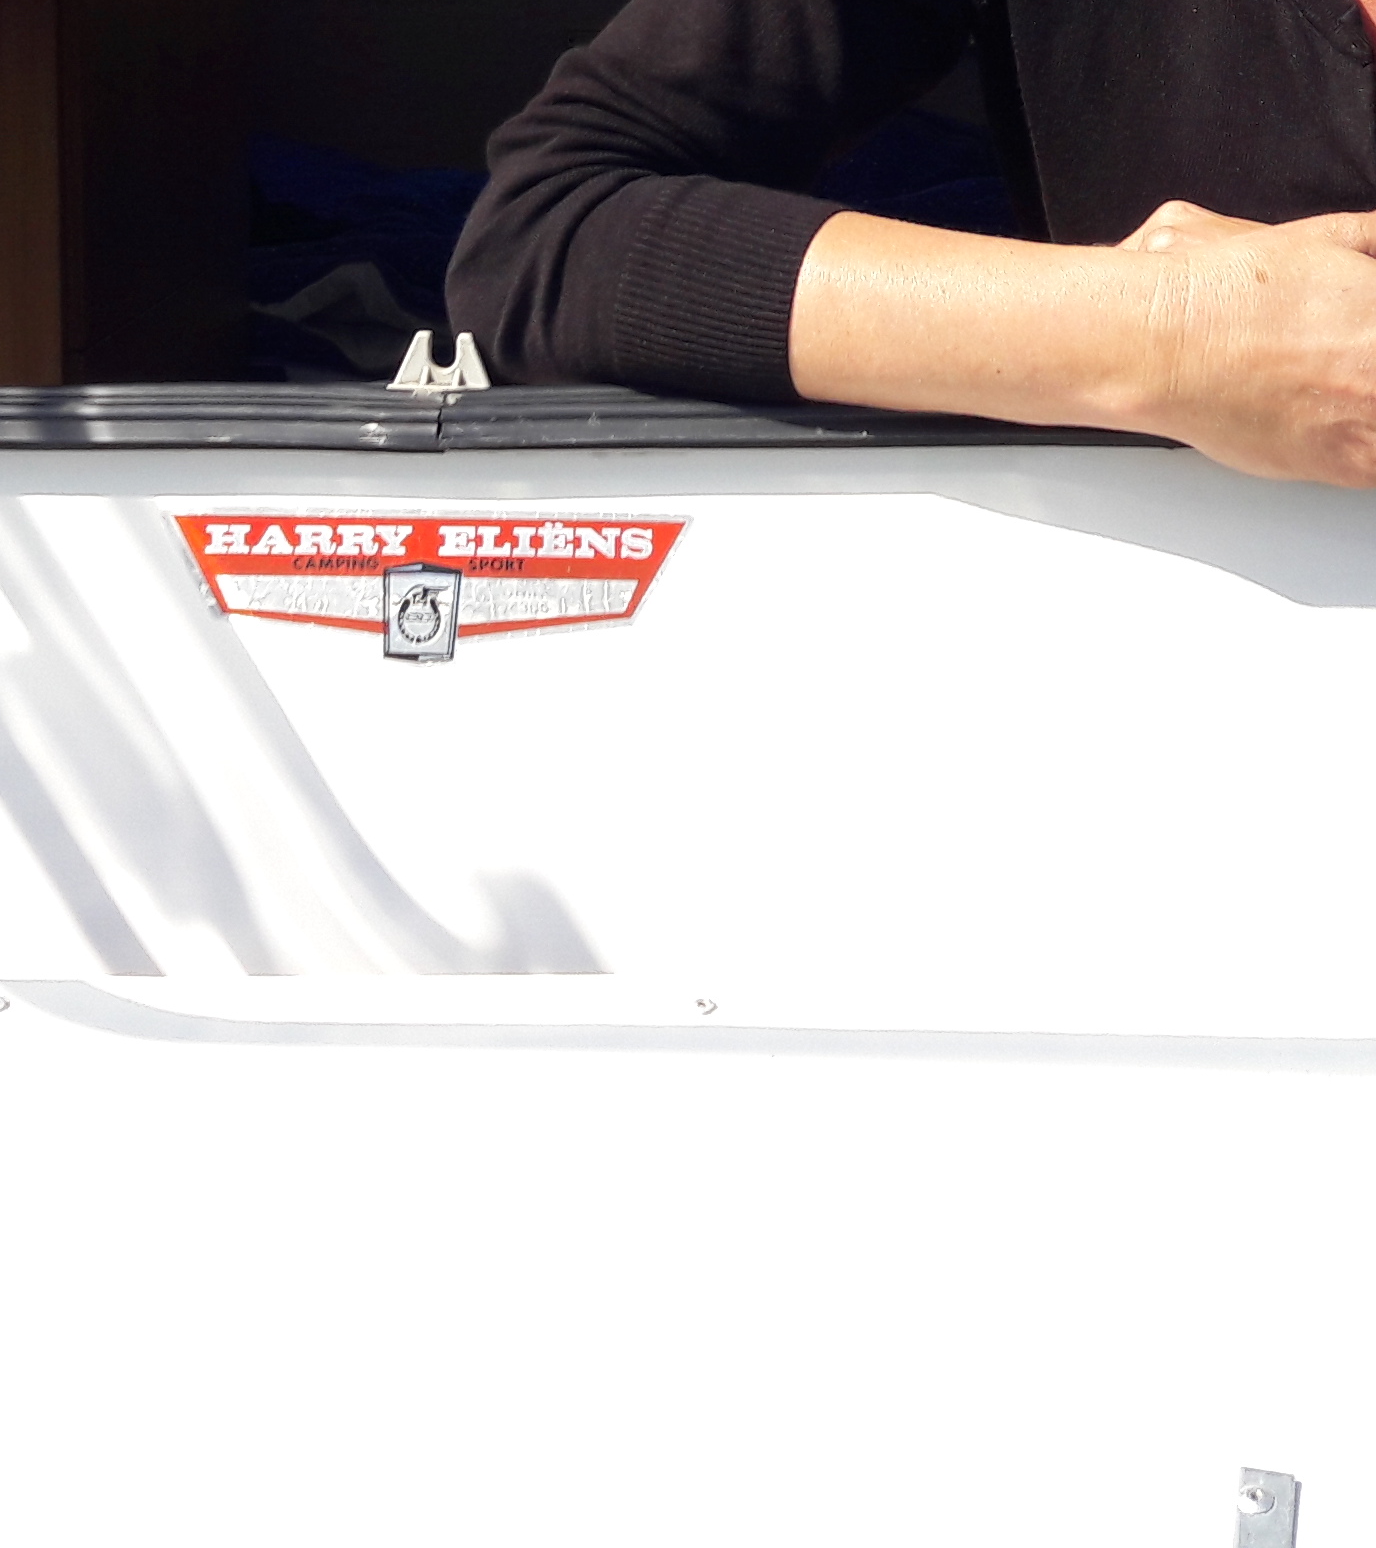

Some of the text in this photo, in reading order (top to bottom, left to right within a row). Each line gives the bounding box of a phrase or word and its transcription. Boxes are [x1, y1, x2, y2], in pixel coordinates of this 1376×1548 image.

[204, 521, 653, 559] HARRY ELIËNS
[293, 557, 526, 572] CAMPING SPORT
